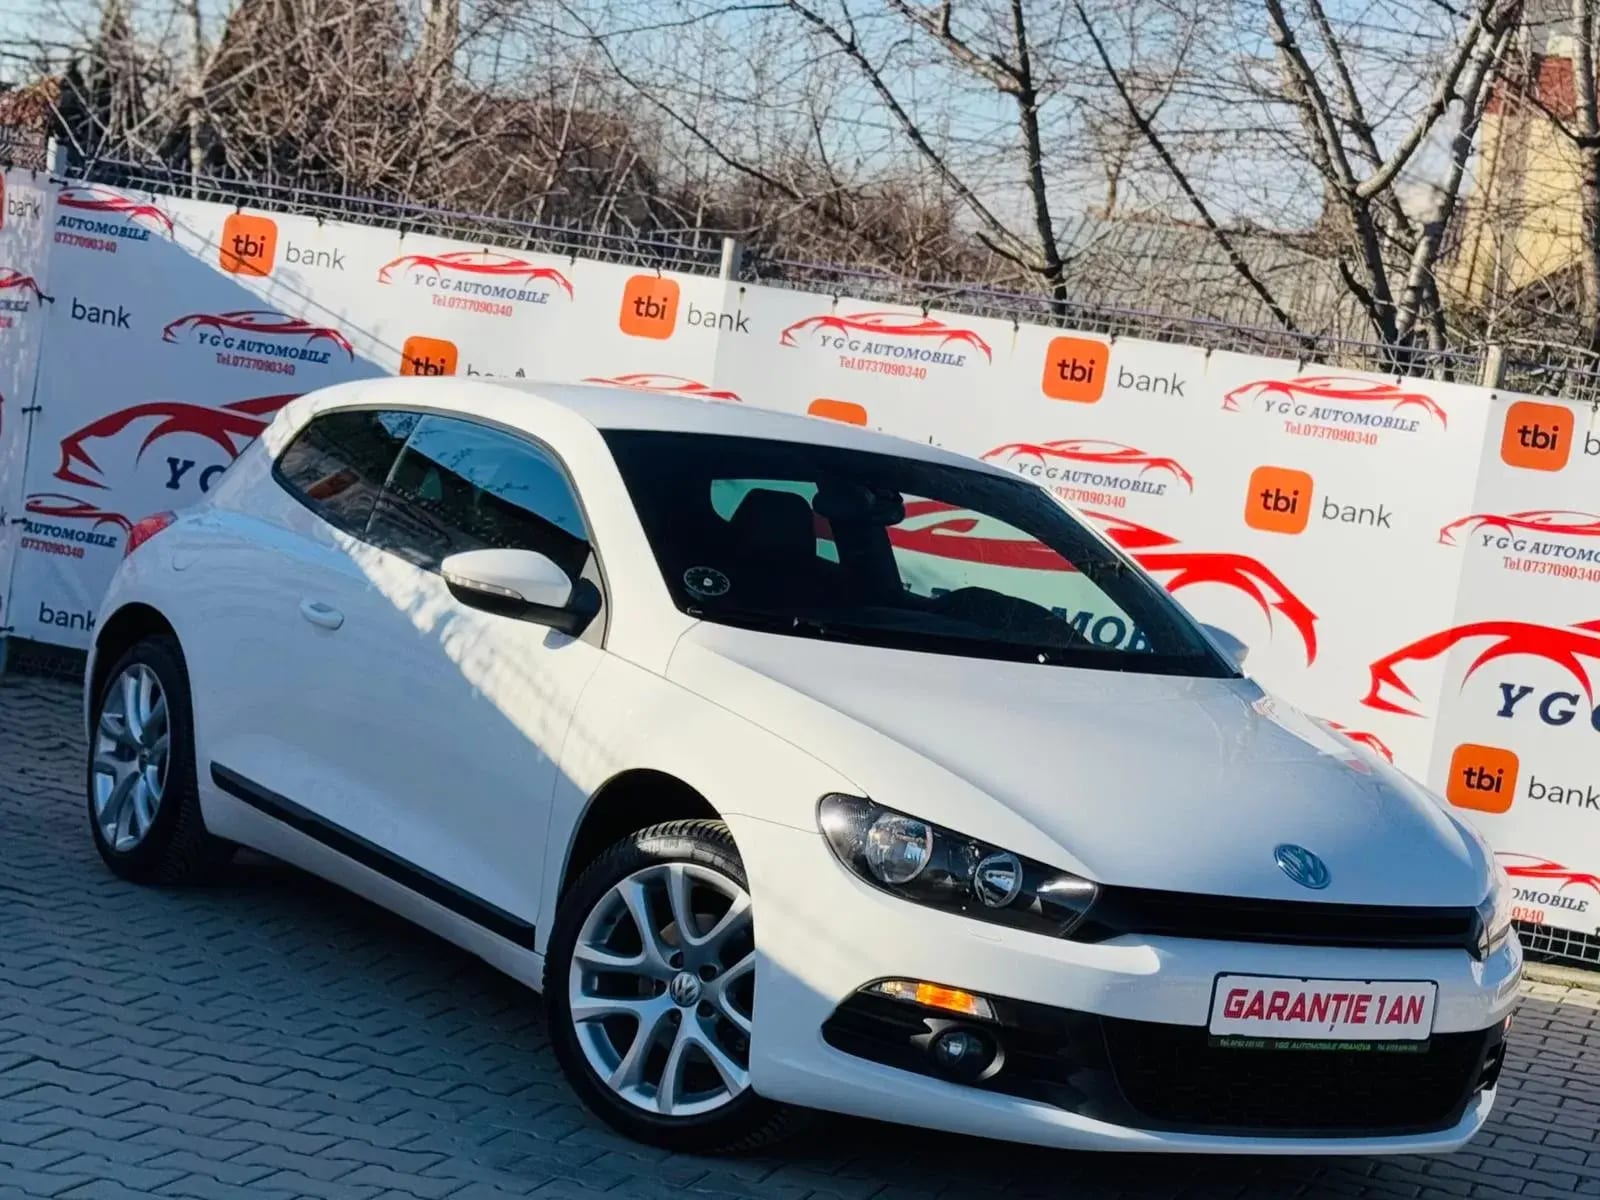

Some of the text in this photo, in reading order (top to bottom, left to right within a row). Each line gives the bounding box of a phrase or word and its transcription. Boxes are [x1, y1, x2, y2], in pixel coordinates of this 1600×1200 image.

[56, 215, 151, 241] AUTOMOBILE
[232, 234, 346, 271] tbi bank
[453, 281, 550, 304] AUTOMOBILE
[72, 297, 132, 329] bank
[634, 296, 750, 333] tbi bank
[236, 340, 331, 364] AUTOMOBILE
[862, 342, 966, 367] AUTOMOBILE
[1057, 358, 1186, 397] tbi bank
[1309, 407, 1420, 432] AUTOMOBILE
[1517, 424, 1559, 451] tbi
[1060, 470, 1167, 496] AUTOMOBILE
[1260, 488, 1393, 528] tbi bank
[24, 521, 117, 548] AUTOMOBILE
[38, 601, 97, 632] bank
[1497, 683, 1534, 718] Y
[1539, 691, 1580, 726] G
[1462, 766, 1600, 811] tbi bank
